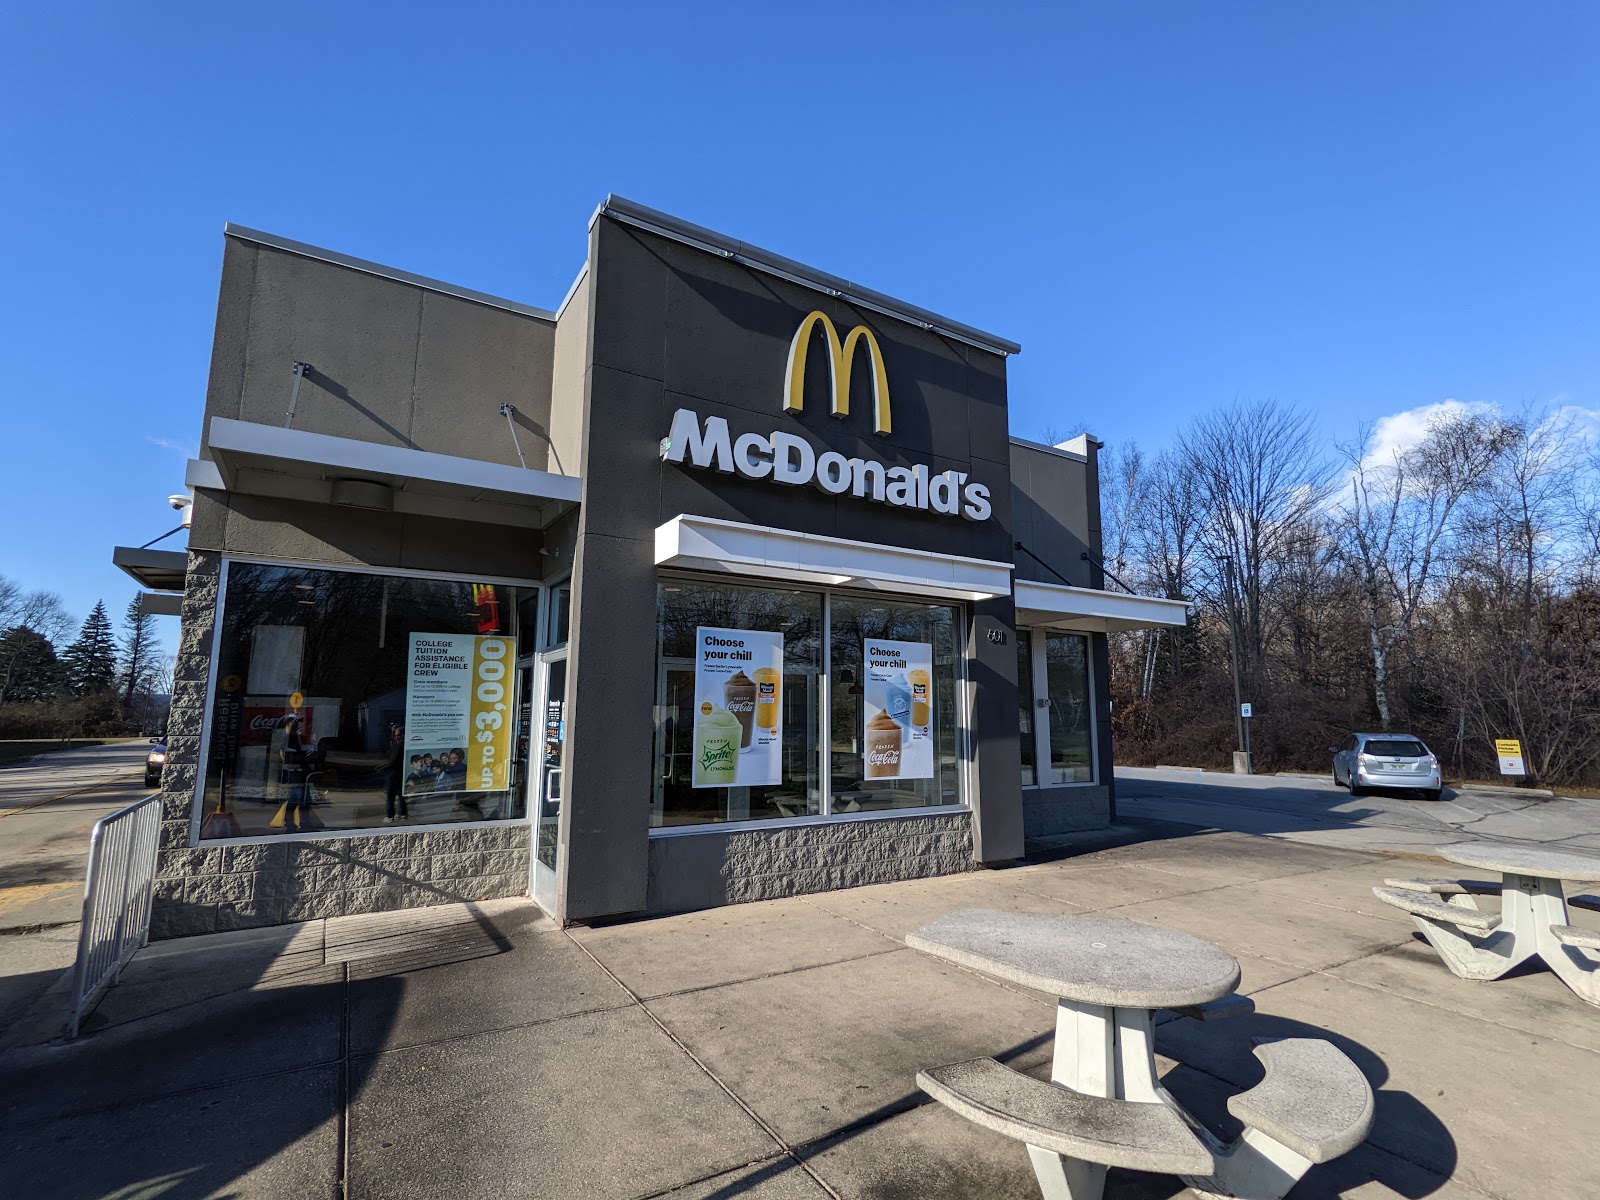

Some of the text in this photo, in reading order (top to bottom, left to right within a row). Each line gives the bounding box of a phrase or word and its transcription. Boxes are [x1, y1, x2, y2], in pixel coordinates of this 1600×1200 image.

[664, 408, 993, 523] McDonald's
[704, 635, 745, 648] Choose
[987, 628, 1003, 643] 601
[415, 640, 453, 648] COLLEGE
[415, 647, 448, 655] TUITION
[704, 650, 752, 661] your chill
[870, 646, 901, 658] Choose
[869, 659, 907, 669] your chill
[475, 639, 507, 788] UP TO $3,000
[703, 750, 731, 762] Sprite
